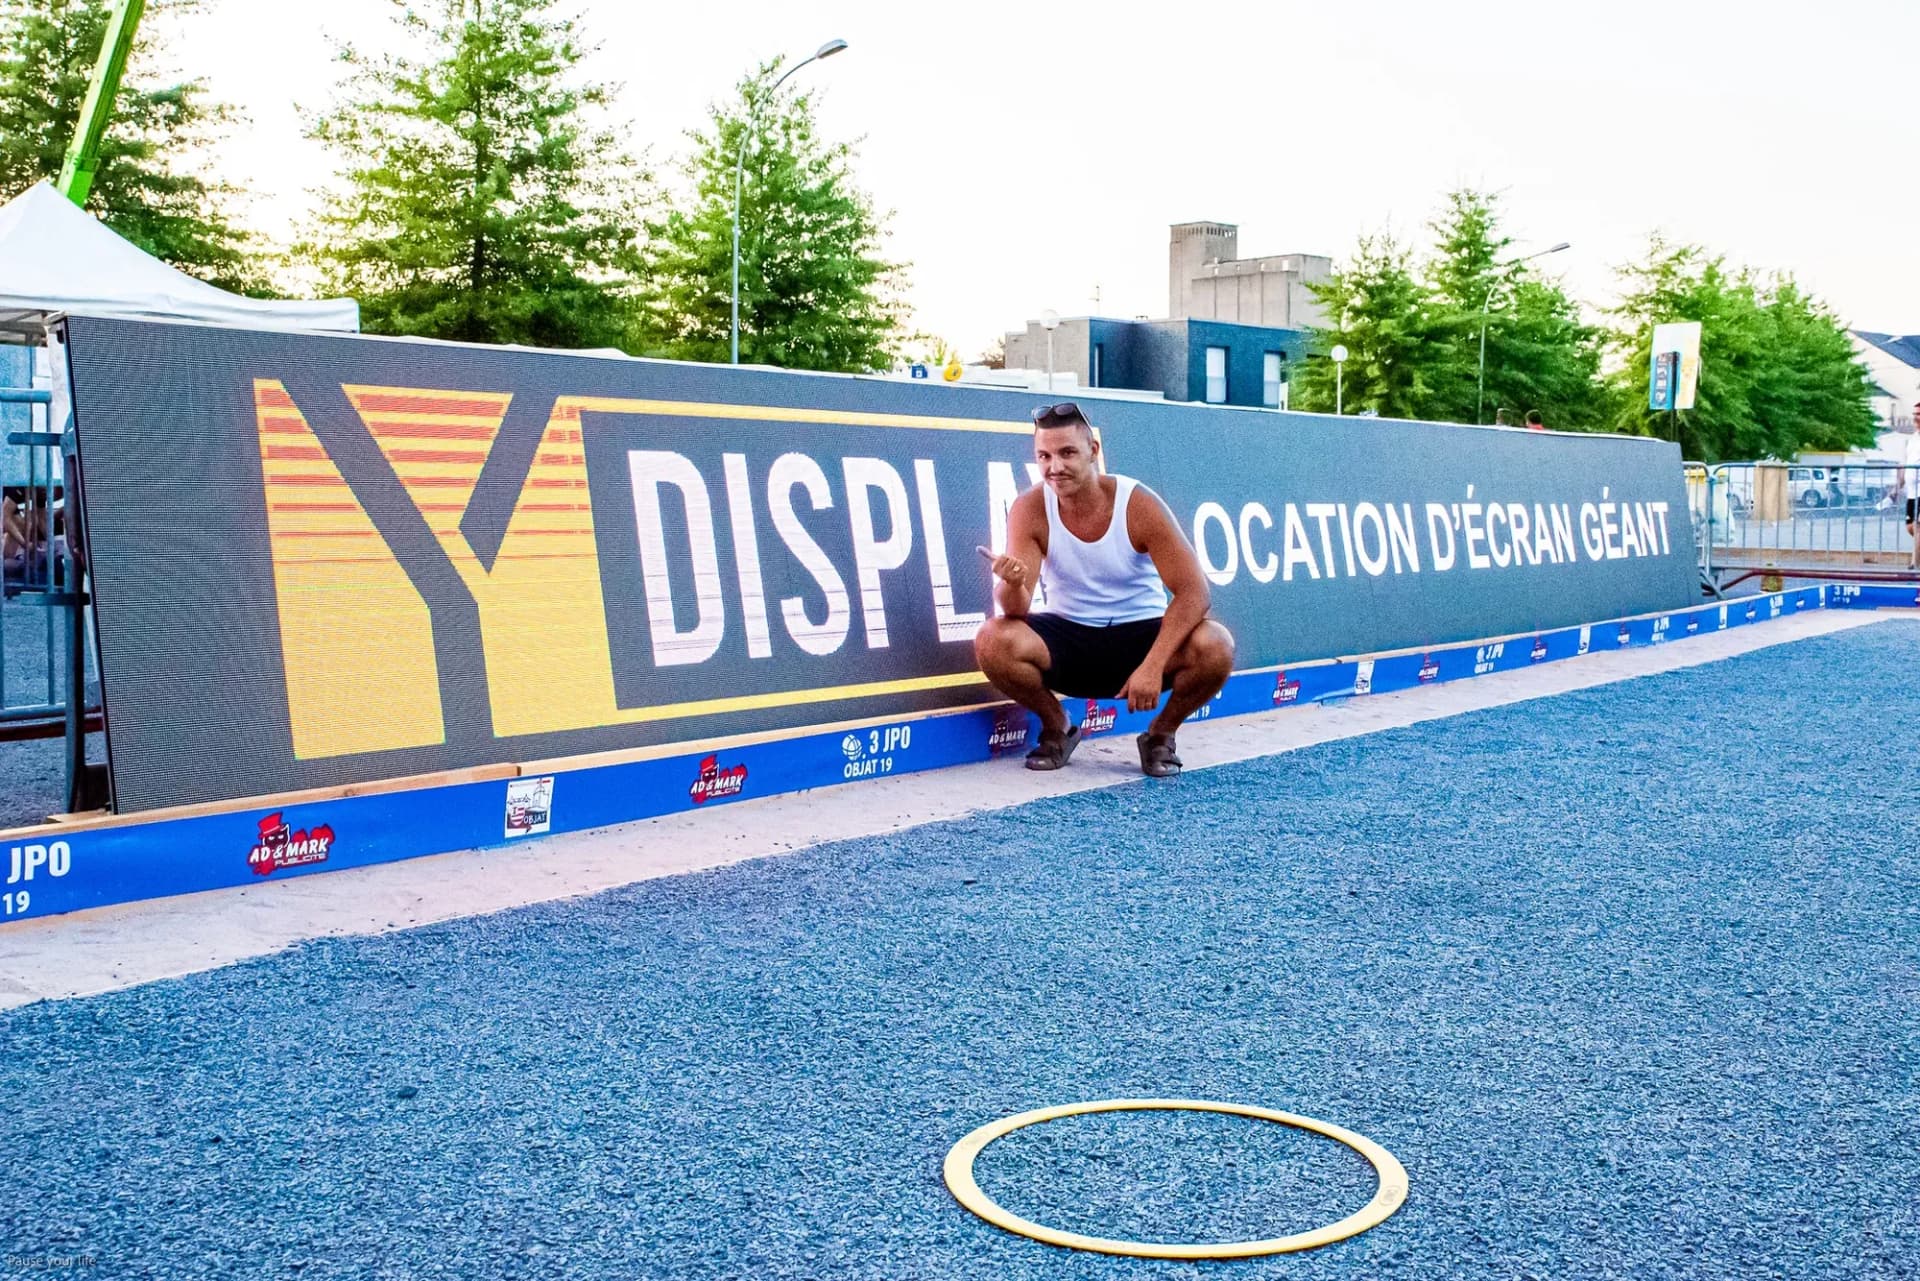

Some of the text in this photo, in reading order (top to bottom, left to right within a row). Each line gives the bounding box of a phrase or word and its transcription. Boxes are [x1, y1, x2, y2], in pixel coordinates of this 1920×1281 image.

[1193, 484, 1670, 586] OCATION D'ÉCRAN GÉANT
[627, 449, 1047, 668] DISPL
[1201, 705, 1210, 717] 19
[869, 725, 911, 754] 3 JPO
[843, 757, 893, 778] OBJAT 19
[690, 781, 705, 795] AD
[713, 774, 744, 790] MARK
[7, 841, 71, 885] JPO
[249, 837, 329, 863] AD & MARK
[2, 890, 31, 915] 19
